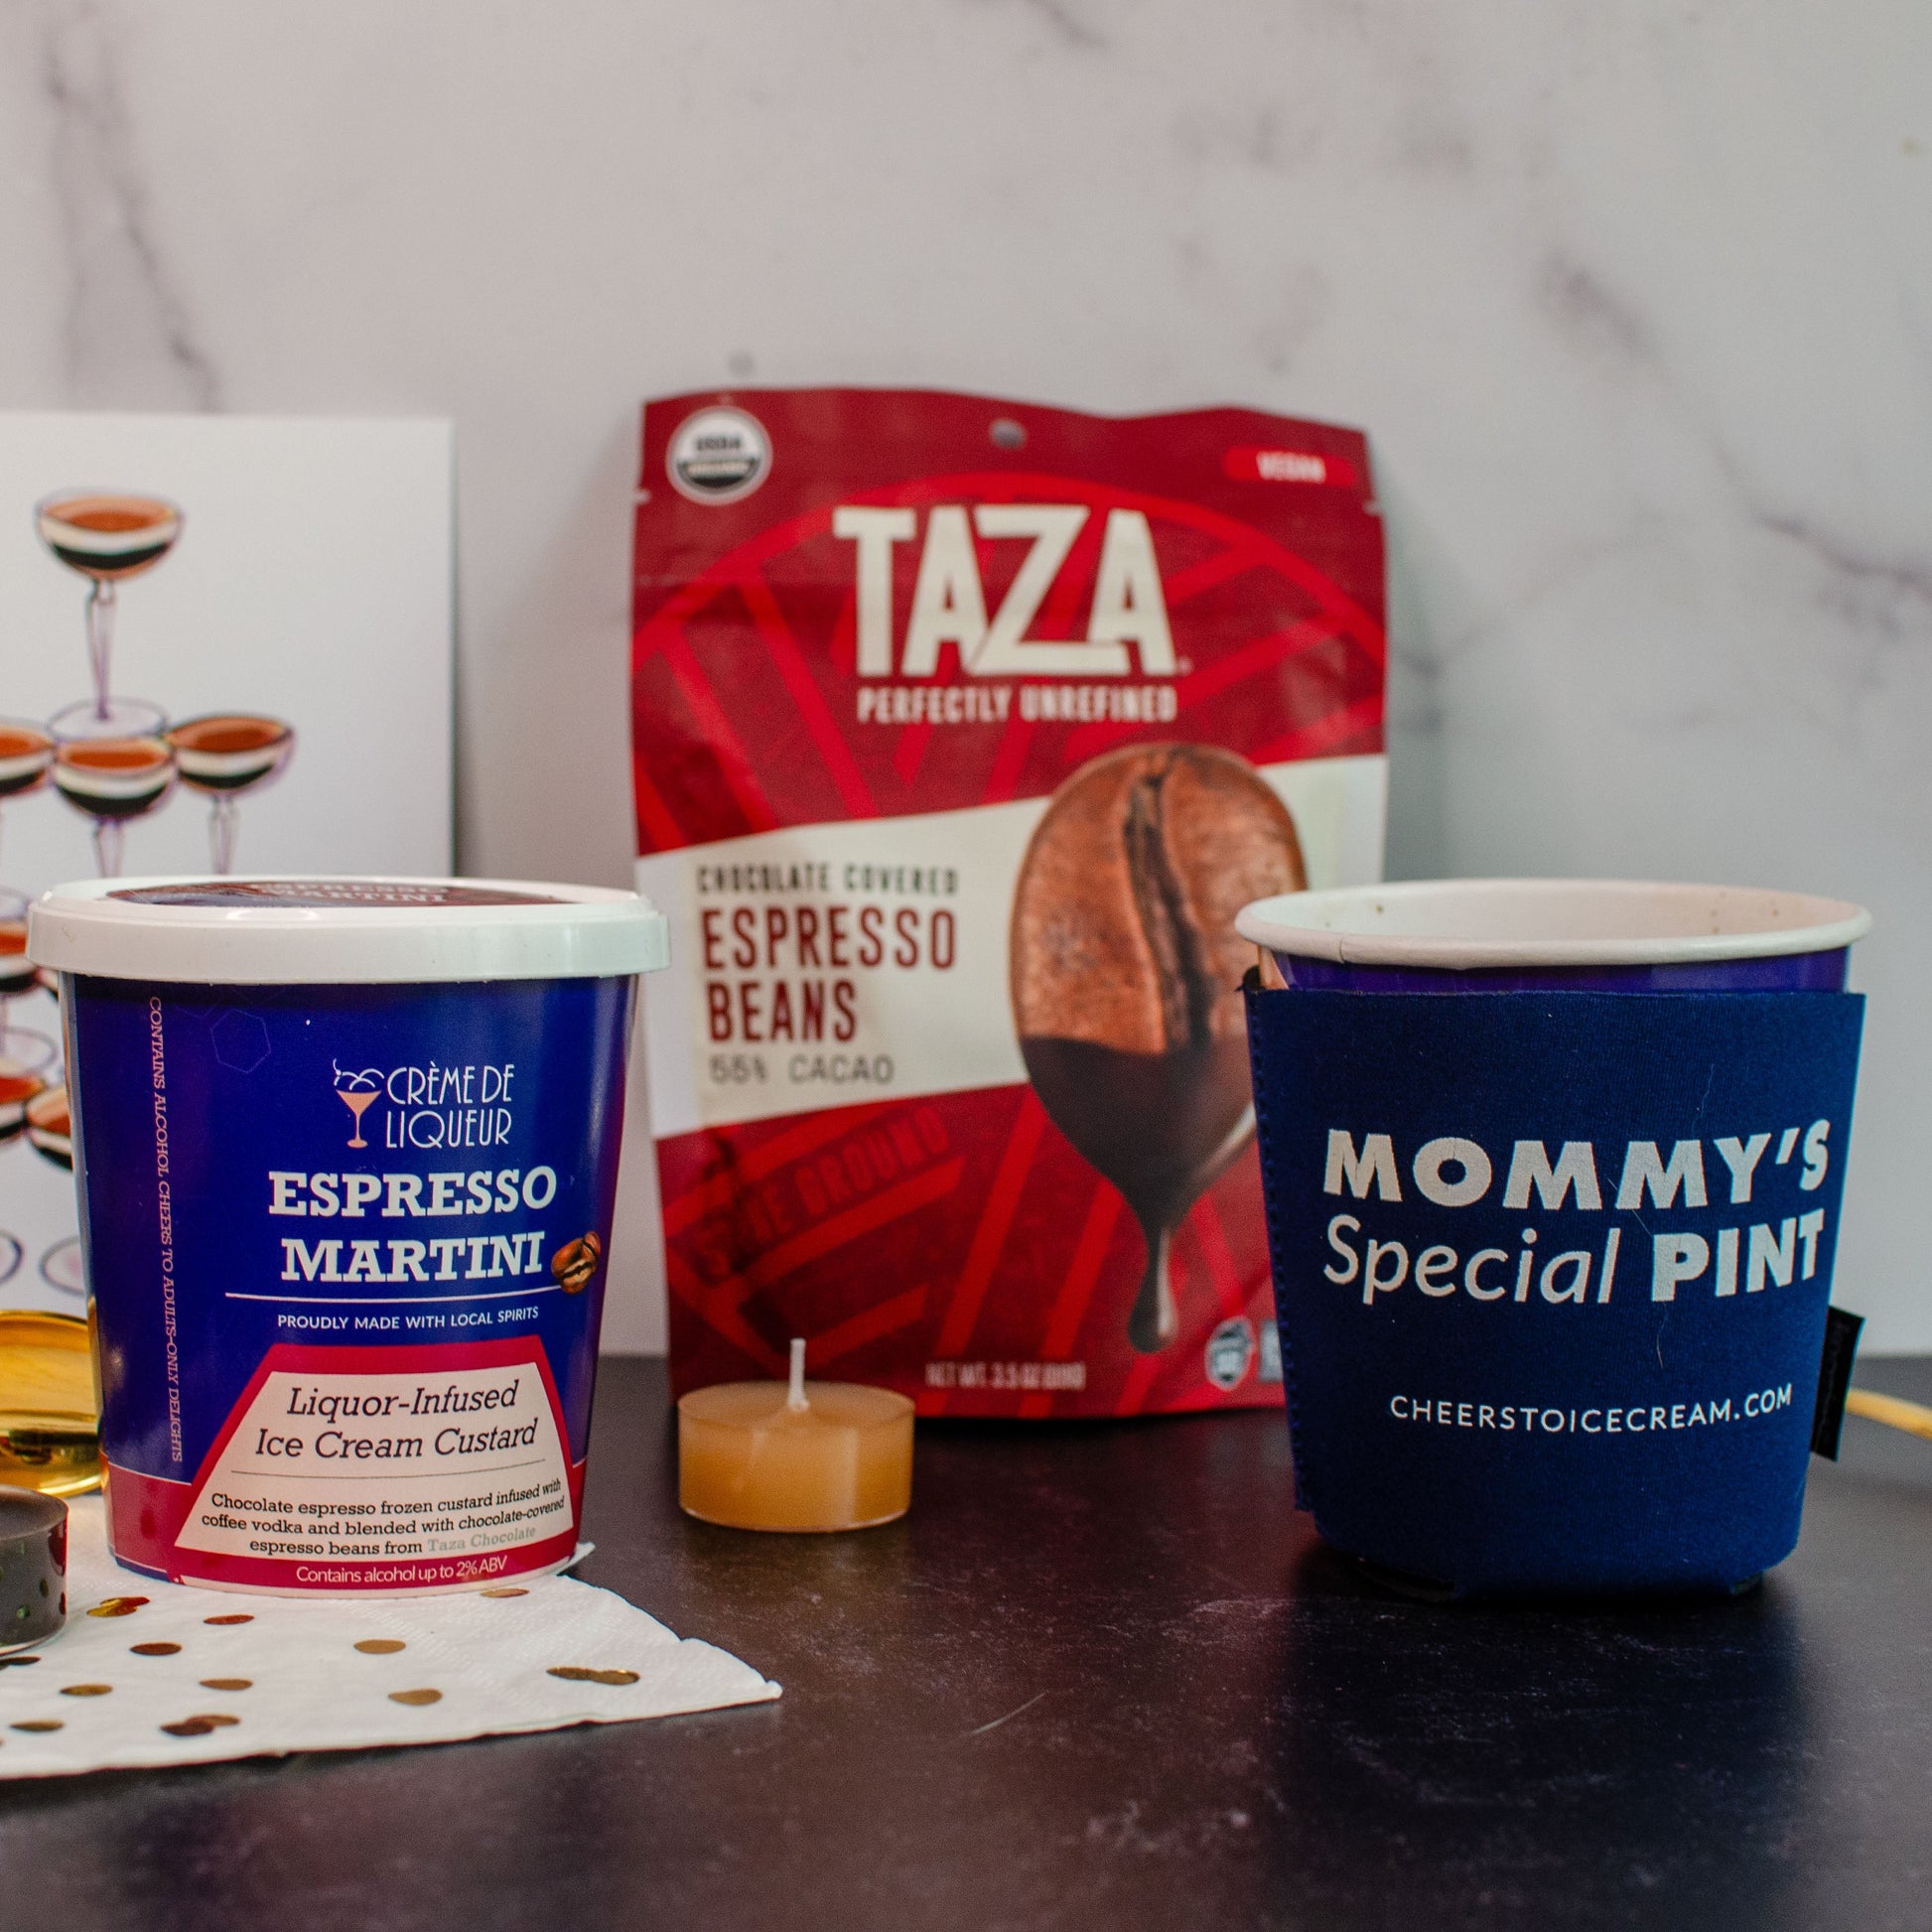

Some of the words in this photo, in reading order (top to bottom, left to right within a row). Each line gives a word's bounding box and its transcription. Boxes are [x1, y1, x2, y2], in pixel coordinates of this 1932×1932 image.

[832, 503, 1176, 678] TAZA
[857, 686, 1012, 723] PERFECTLY
[1020, 686, 1178, 723] UNREFINED
[697, 862, 830, 895] CHOCOLATE
[843, 865, 959, 895] COVERED
[701, 904, 956, 971] ESPRESSO
[706, 978, 858, 1042] BEANS
[150, 996, 165, 1089] CONTAINS
[386, 1061, 476, 1105] CRÈME
[483, 1064, 514, 1102] DE
[787, 1053, 895, 1085] CACAO
[154, 1092, 169, 1177] ALCOHOL
[386, 1108, 512, 1150] LIQUEUR
[1322, 1119, 1831, 1210] MOMMY'S
[158, 1180, 173, 1245] CHEERS
[268, 1166, 558, 1217] ESPRESSO
[162, 1248, 174, 1273] TO
[280, 1231, 545, 1283] MARTINI
[1322, 1214, 1621, 1306] Special
[1650, 1207, 1826, 1303] PINT
[277, 1314, 348, 1330] PROUDLY
[354, 1316, 400, 1330] MADE
[404, 1314, 446, 1329] WITH
[450, 1311, 493, 1327] LOCAL
[496, 1306, 539, 1323] SPIRITS
[286, 1379, 520, 1424] Liquor-Infused
[1390, 1383, 1792, 1434] CHEERSTOICECREAM.COM
[168, 1387, 183, 1462] DELIGHTS
[255, 1428, 304, 1458] Ice
[315, 1432, 423, 1459] Cream
[434, 1417, 538, 1455] Custard
[202, 1513, 248, 1531] coffee
[252, 1518, 303, 1534] vodka
[308, 1519, 341, 1536] and
[345, 1516, 417, 1536] blended
[421, 1514, 455, 1533] with
[459, 1495, 566, 1531] chocolate-covered
[211, 1492, 294, 1514] Chocolate
[298, 1500, 376, 1517] espresso
[380, 1497, 434, 1515] frozen
[439, 1492, 492, 1512] custard
[495, 1483, 540, 1506] infused
[542, 1478, 562, 1496] with
[249, 1538, 325, 1557] espresso
[329, 1537, 379, 1556] beans
[385, 1536, 423, 1555] from
[428, 1536, 467, 1553] Taza
[471, 1525, 536, 1549] Chocolate
[296, 1566, 361, 1584] Contains
[363, 1563, 416, 1584] alcohol
[418, 1567, 438, 1584] up
[440, 1565, 454, 1579] to
[457, 1560, 478, 1577] 2%
[479, 1555, 507, 1574] ABV
